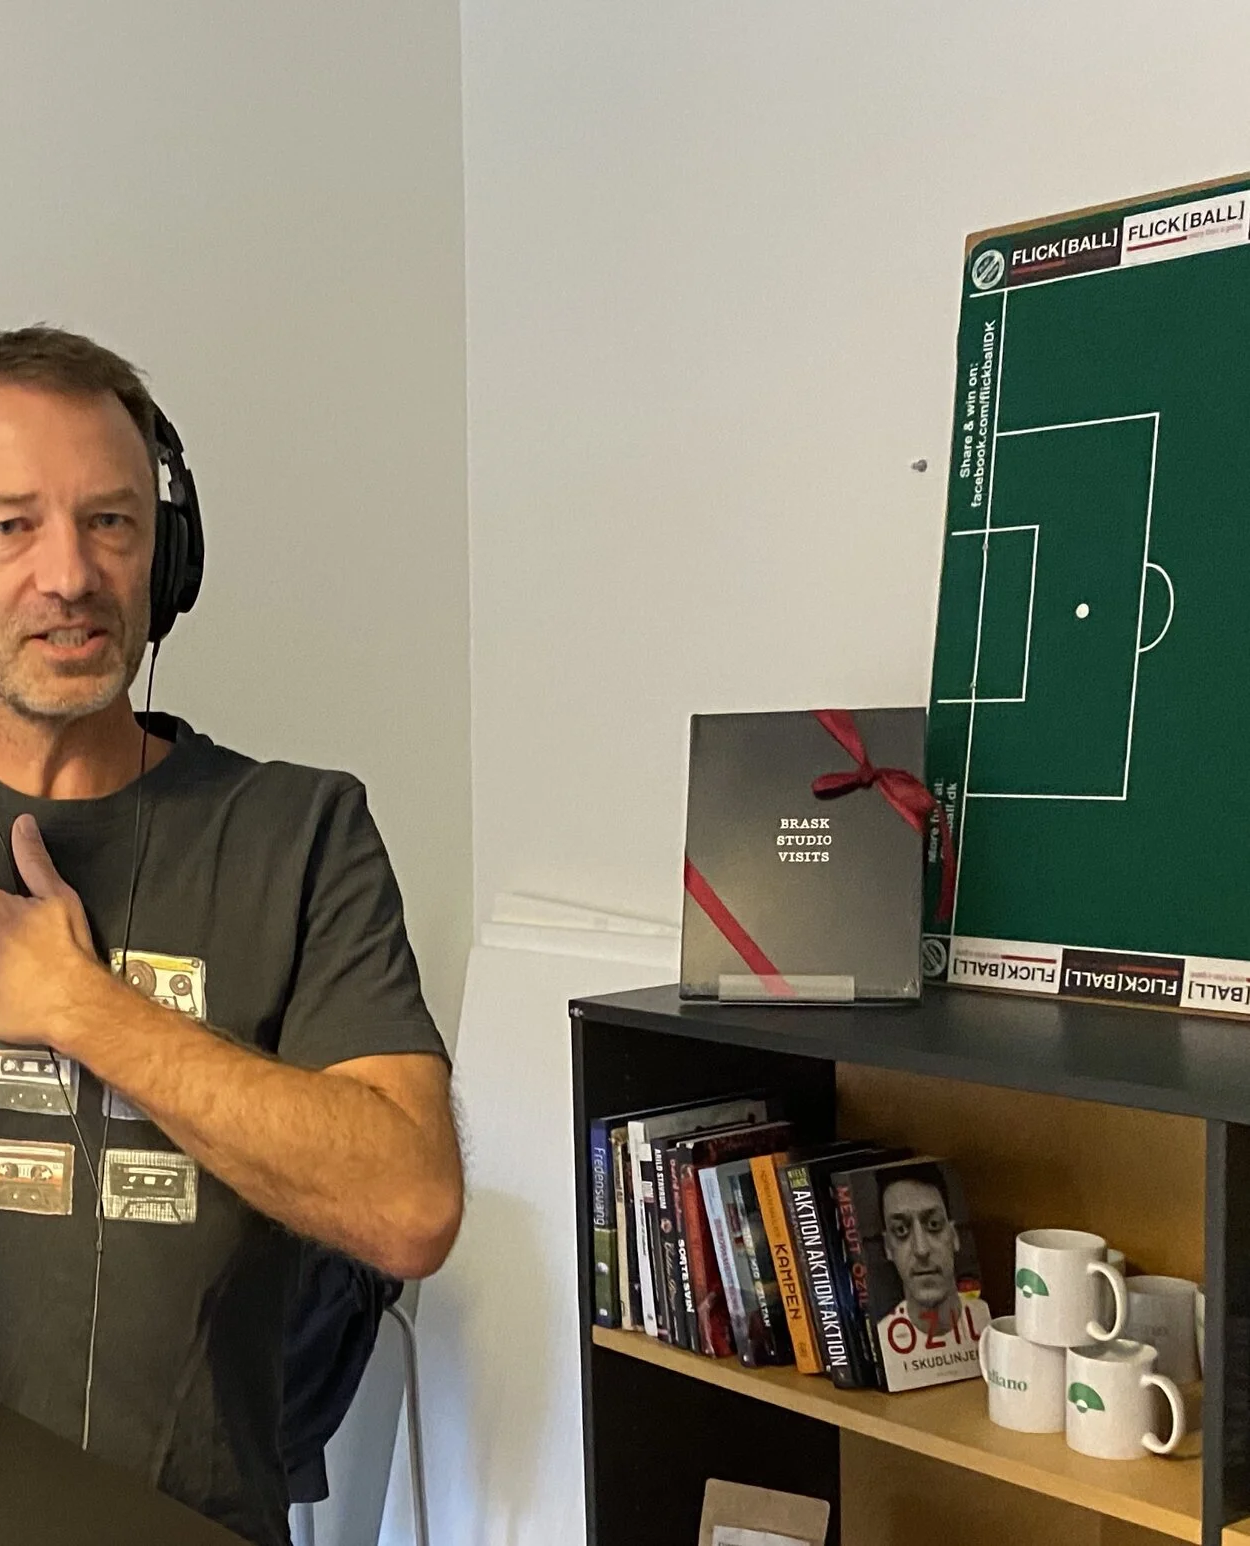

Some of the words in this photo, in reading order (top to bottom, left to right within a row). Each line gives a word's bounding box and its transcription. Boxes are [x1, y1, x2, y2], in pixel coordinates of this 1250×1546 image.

[1128, 200, 1245, 241] FLICK[BALL]
[1011, 227, 1119, 266] FLICK[BALL]
[968, 362, 979, 387] on:
[966, 390, 976, 416] win
[963, 420, 974, 431] &
[959, 435, 973, 478] Share
[776, 835, 832, 846] STUDIO
[780, 818, 830, 829] BRASK
[778, 852, 830, 862] VISITS
[953, 958, 1055, 983] FLICK[BALL]
[1064, 969, 1178, 996] FLICK[BALL]
[654, 1148, 663, 1171] ARILD
[793, 1190, 822, 1246] AKTION
[837, 1185, 861, 1255] MESUT
[678, 1239, 689, 1280] SORTE
[774, 1243, 801, 1320] KAMPEN
[806, 1250, 834, 1306] AKTION
[683, 1281, 694, 1313] SVIN
[820, 1310, 848, 1366] AKTION
[888, 1305, 981, 1354] ÖZIL
